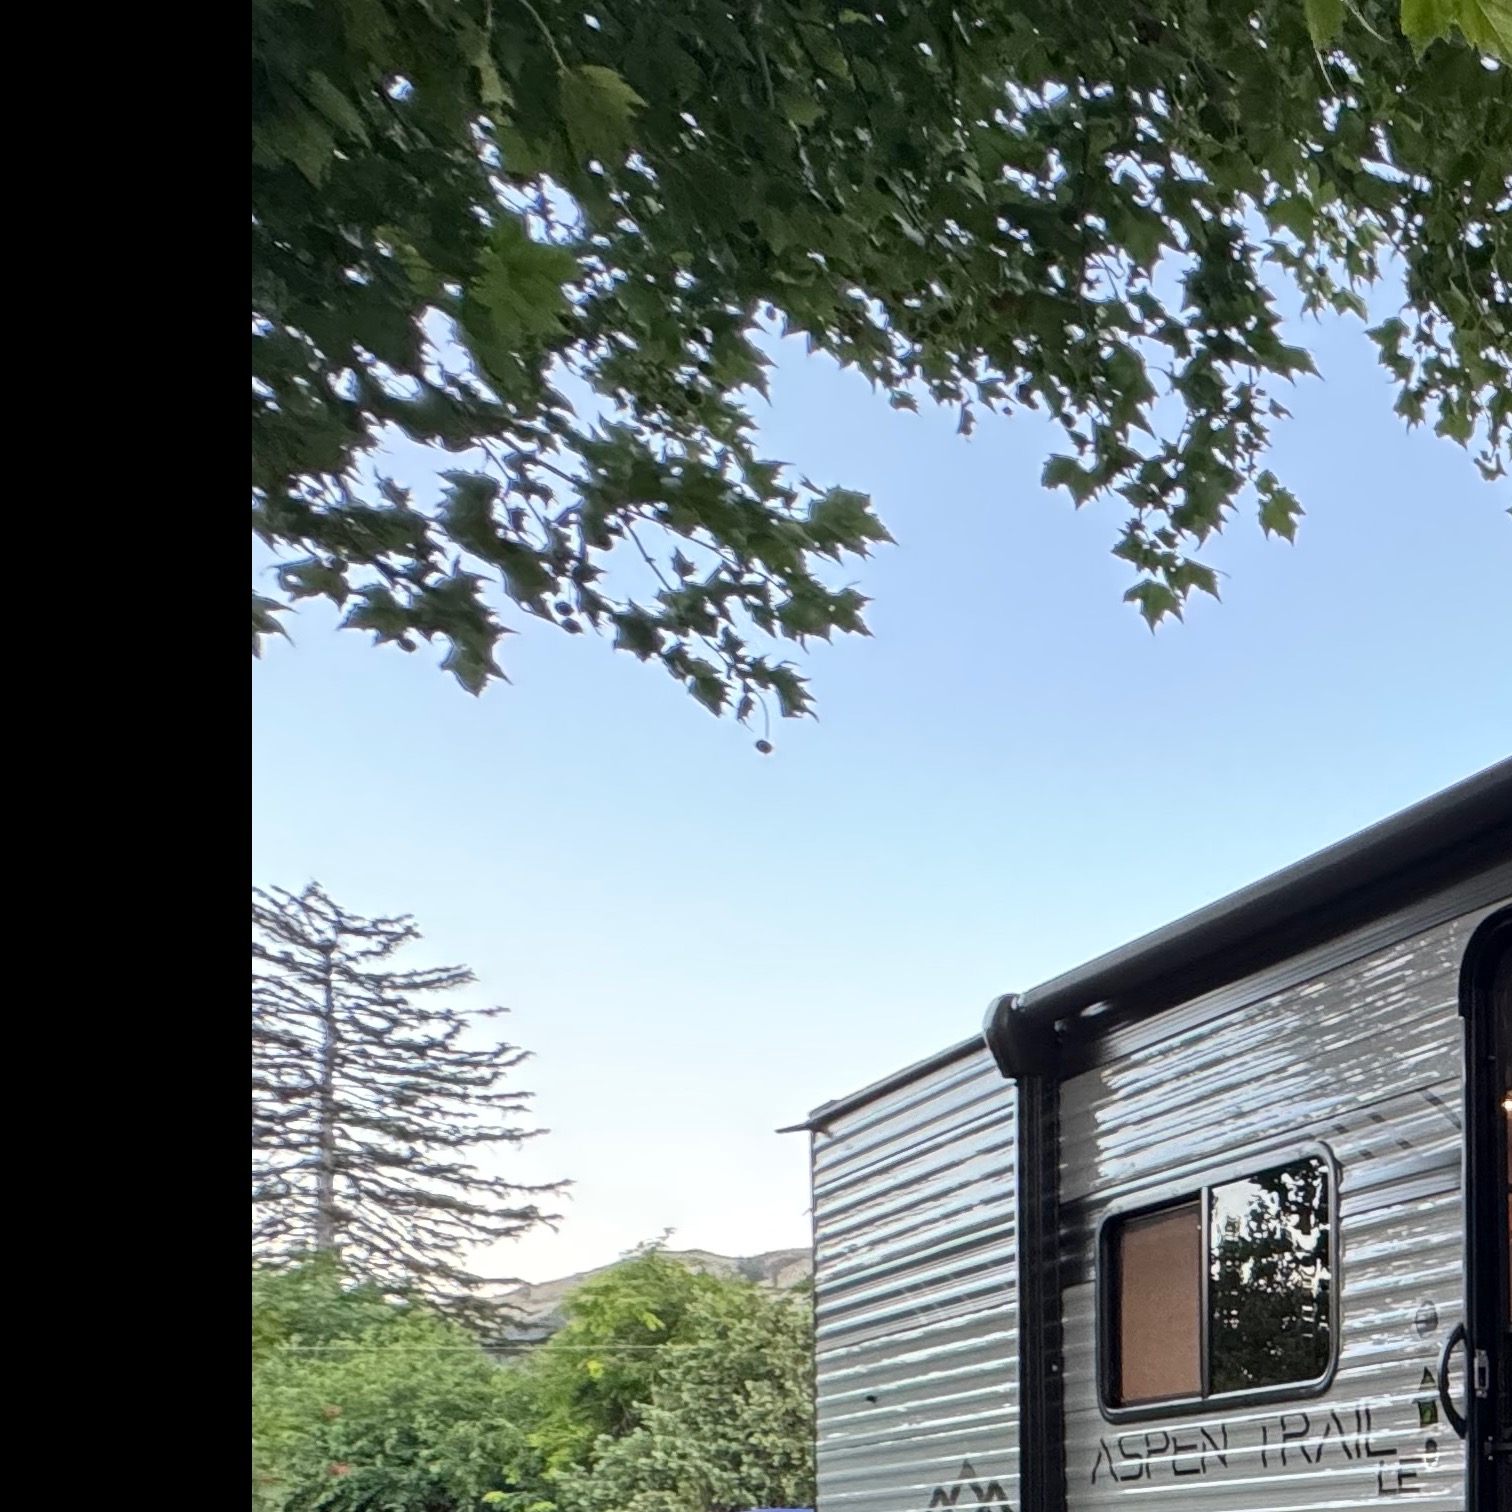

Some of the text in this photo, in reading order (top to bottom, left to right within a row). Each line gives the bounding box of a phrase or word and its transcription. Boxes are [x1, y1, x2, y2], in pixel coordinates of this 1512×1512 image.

[1091, 1404, 1397, 1484] ASPEN TRAIL
[1376, 1458, 1424, 1495] LE
